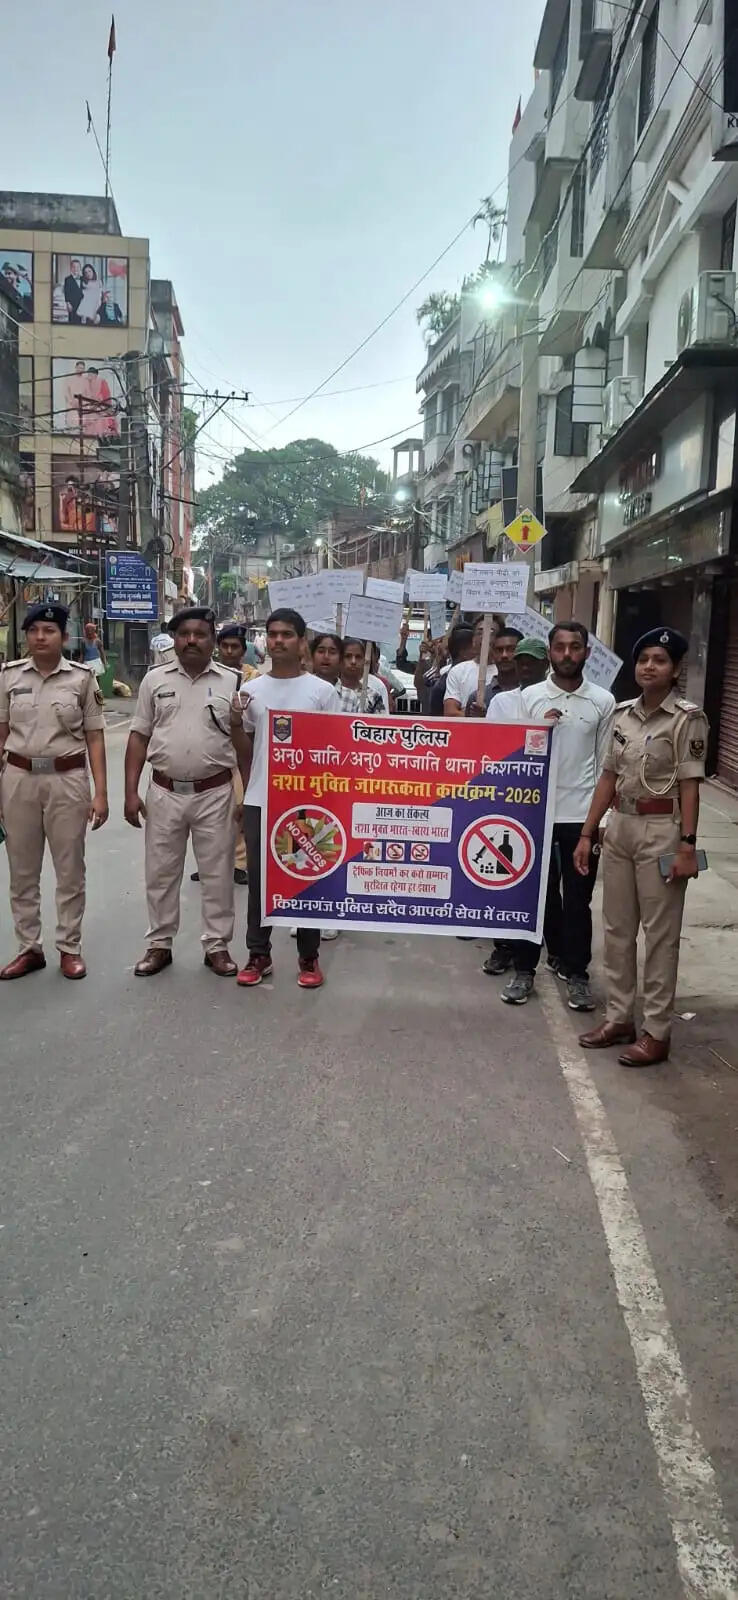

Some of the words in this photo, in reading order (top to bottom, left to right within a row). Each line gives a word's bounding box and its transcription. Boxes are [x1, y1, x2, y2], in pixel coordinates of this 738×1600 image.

[352, 721, 397, 744] बिहार
[401, 724, 450, 750] पुलिस
[386, 750, 441, 772] जनजाति
[445, 757, 477, 774] थाना
[480, 754, 545, 777] किशनगंज
[272, 774, 306, 791] नशा
[375, 806, 393, 818] आज
[394, 808, 405, 818] का
[407, 806, 430, 819] संकल्प
[354, 823, 370, 833] नशा
[371, 823, 388, 837] मुक्त
[431, 827, 449, 838] भारत
[285, 821, 301, 837] NO
[297, 835, 327, 868] DRUGS
[272, 894, 333, 912] किशनगंज
[335, 897, 374, 917] पुलिस
[376, 899, 406, 916] सदैव
[408, 903, 453, 918] आपकी
[455, 904, 481, 920] सेवा
[483, 905, 496, 920] में
[497, 909, 530, 922] तत्पर
